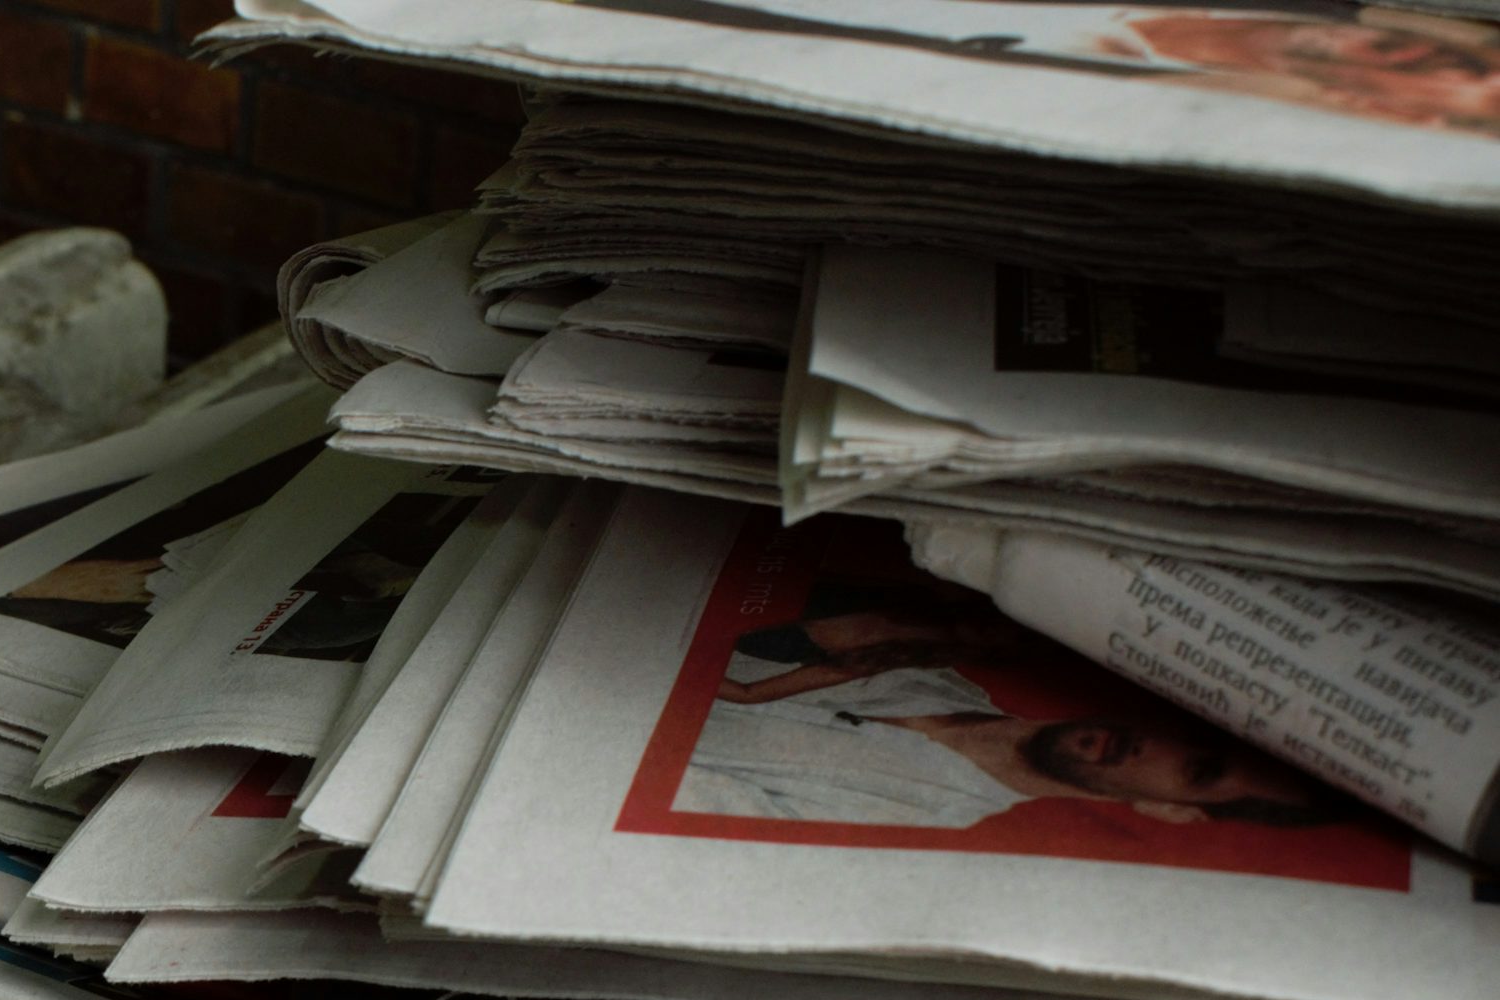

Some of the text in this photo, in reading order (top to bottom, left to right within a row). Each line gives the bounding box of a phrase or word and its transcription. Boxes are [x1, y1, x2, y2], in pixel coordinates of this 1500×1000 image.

[251, 591, 305, 633] страна
[1123, 576, 1208, 633] према
[1142, 548, 1475, 737] расположење навијача
[1327, 612, 1364, 639] је
[1103, 630, 1235, 714] Стојковић
[1240, 707, 1273, 735] је
[1138, 616, 1160, 641] У
[1172, 640, 1290, 717] подкасту
